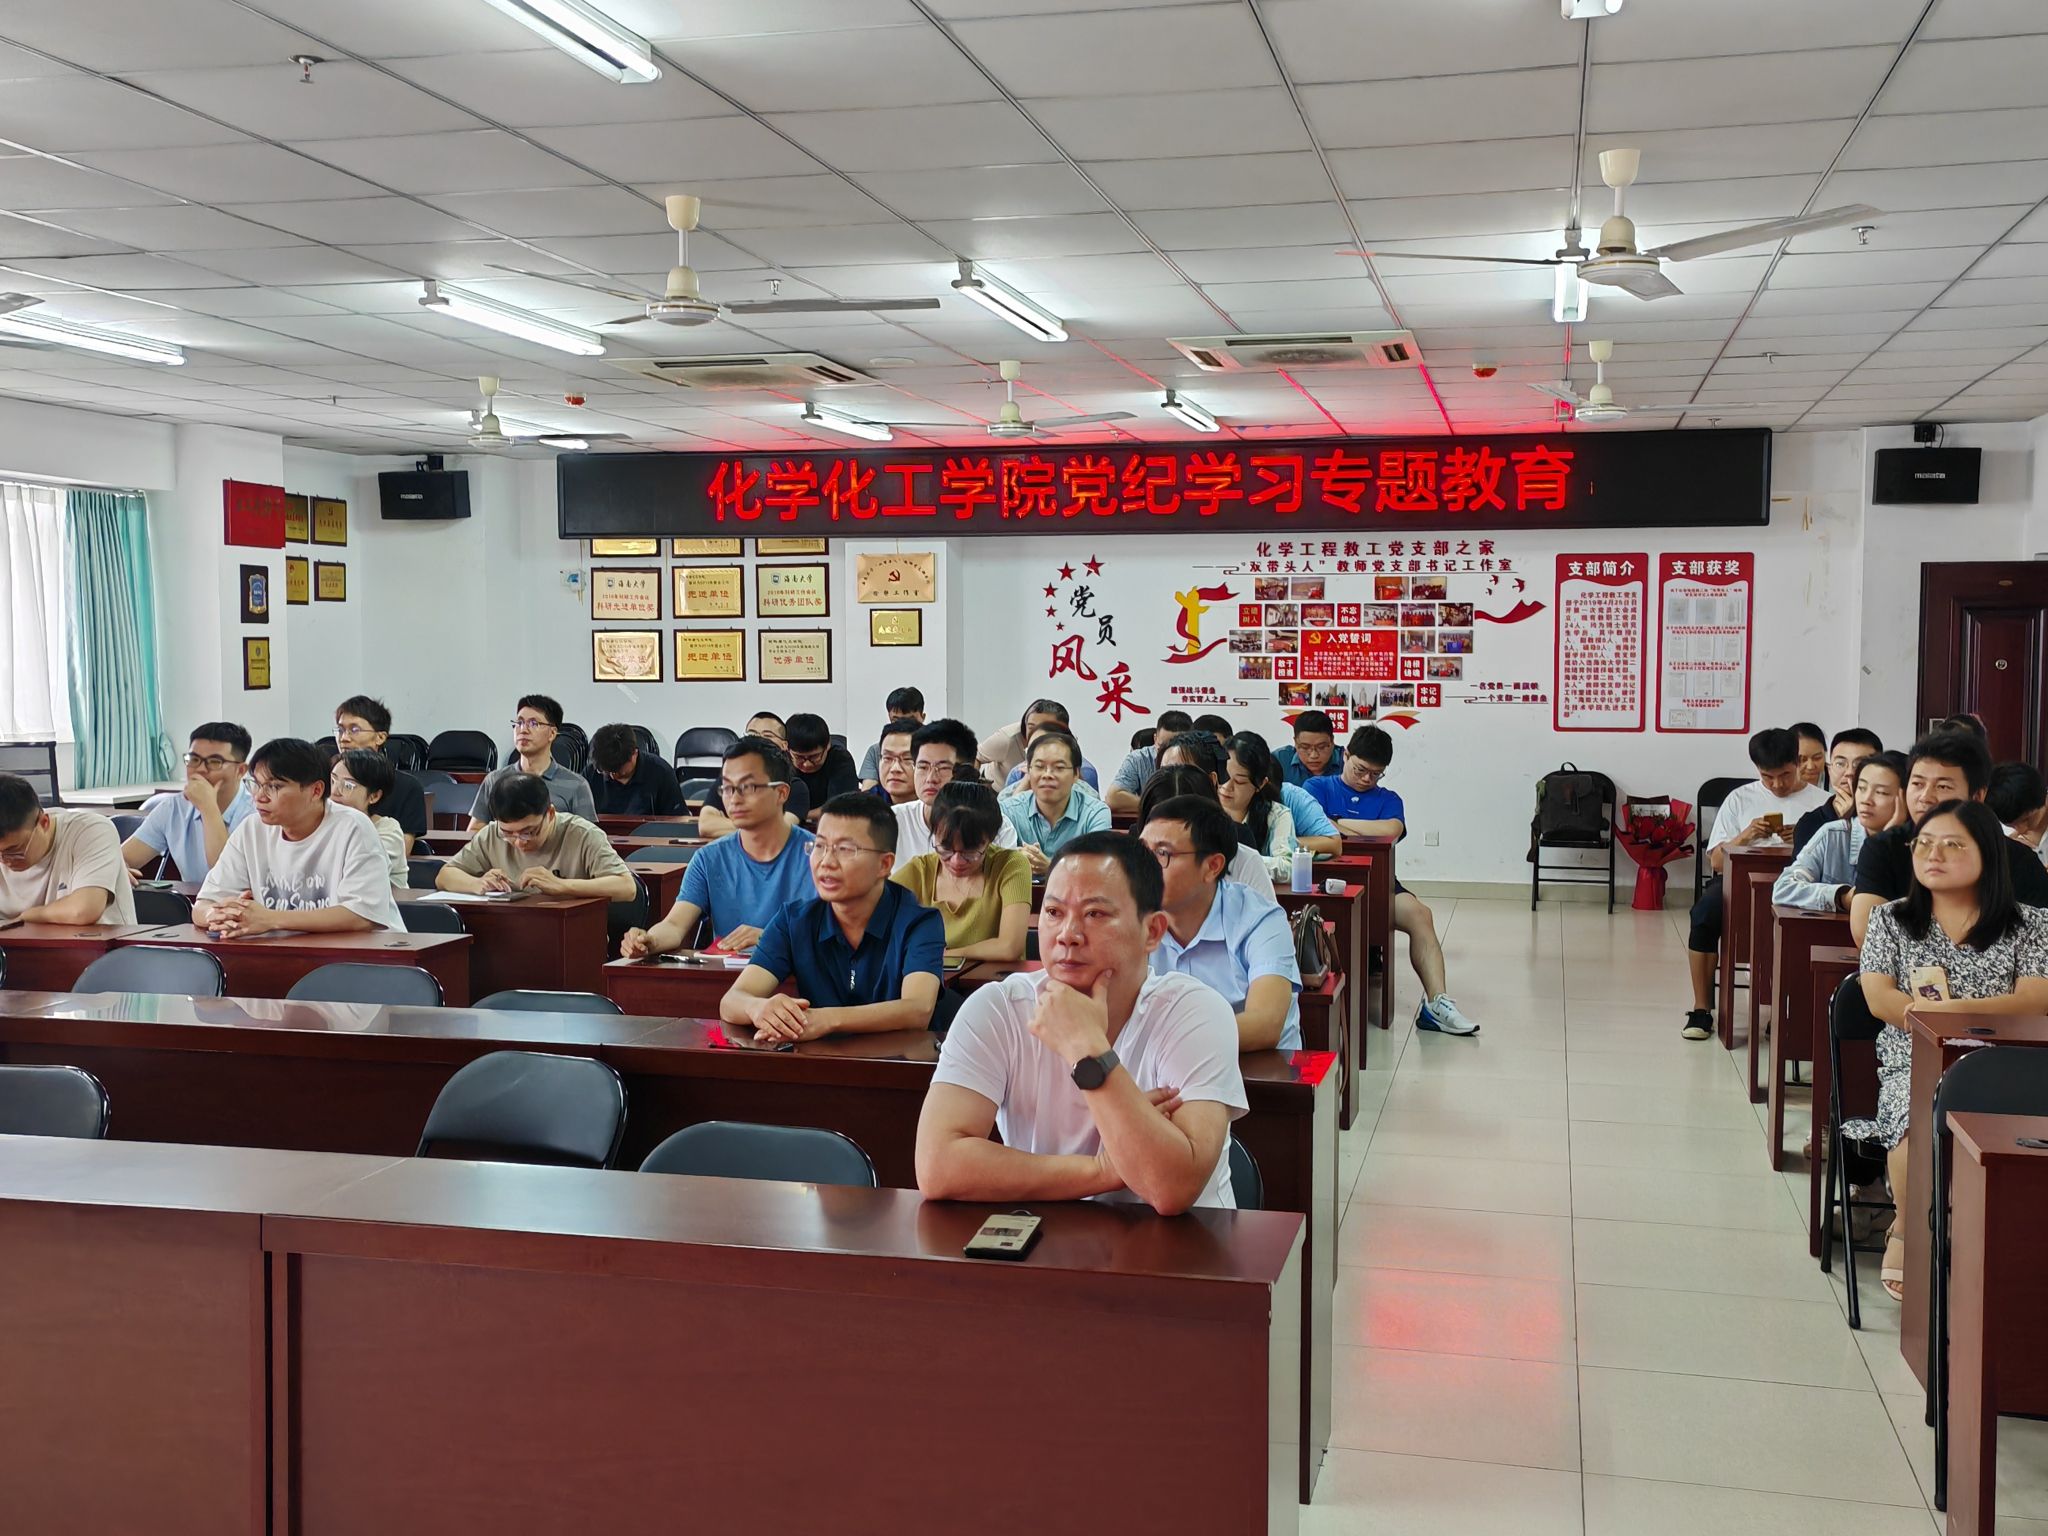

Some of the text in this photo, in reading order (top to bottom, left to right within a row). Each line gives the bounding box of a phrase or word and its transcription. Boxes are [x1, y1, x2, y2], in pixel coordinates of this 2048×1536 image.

[707, 444, 1575, 521] 化学化工学院党纪学习专题教育
[1256, 540, 1495, 557] 化学工程教工党支部之家
[1568, 560, 1635, 576] 支部简介
[1671, 559, 1740, 576] 支部获奖
[1069, 584, 1117, 647] 党员
[1340, 606, 1357, 614] 不忘
[1340, 615, 1357, 624] 初心
[1326, 632, 1372, 644] 入党誓词
[1049, 634, 1151, 723] 风采
[1420, 686, 1437, 696] 牢记
